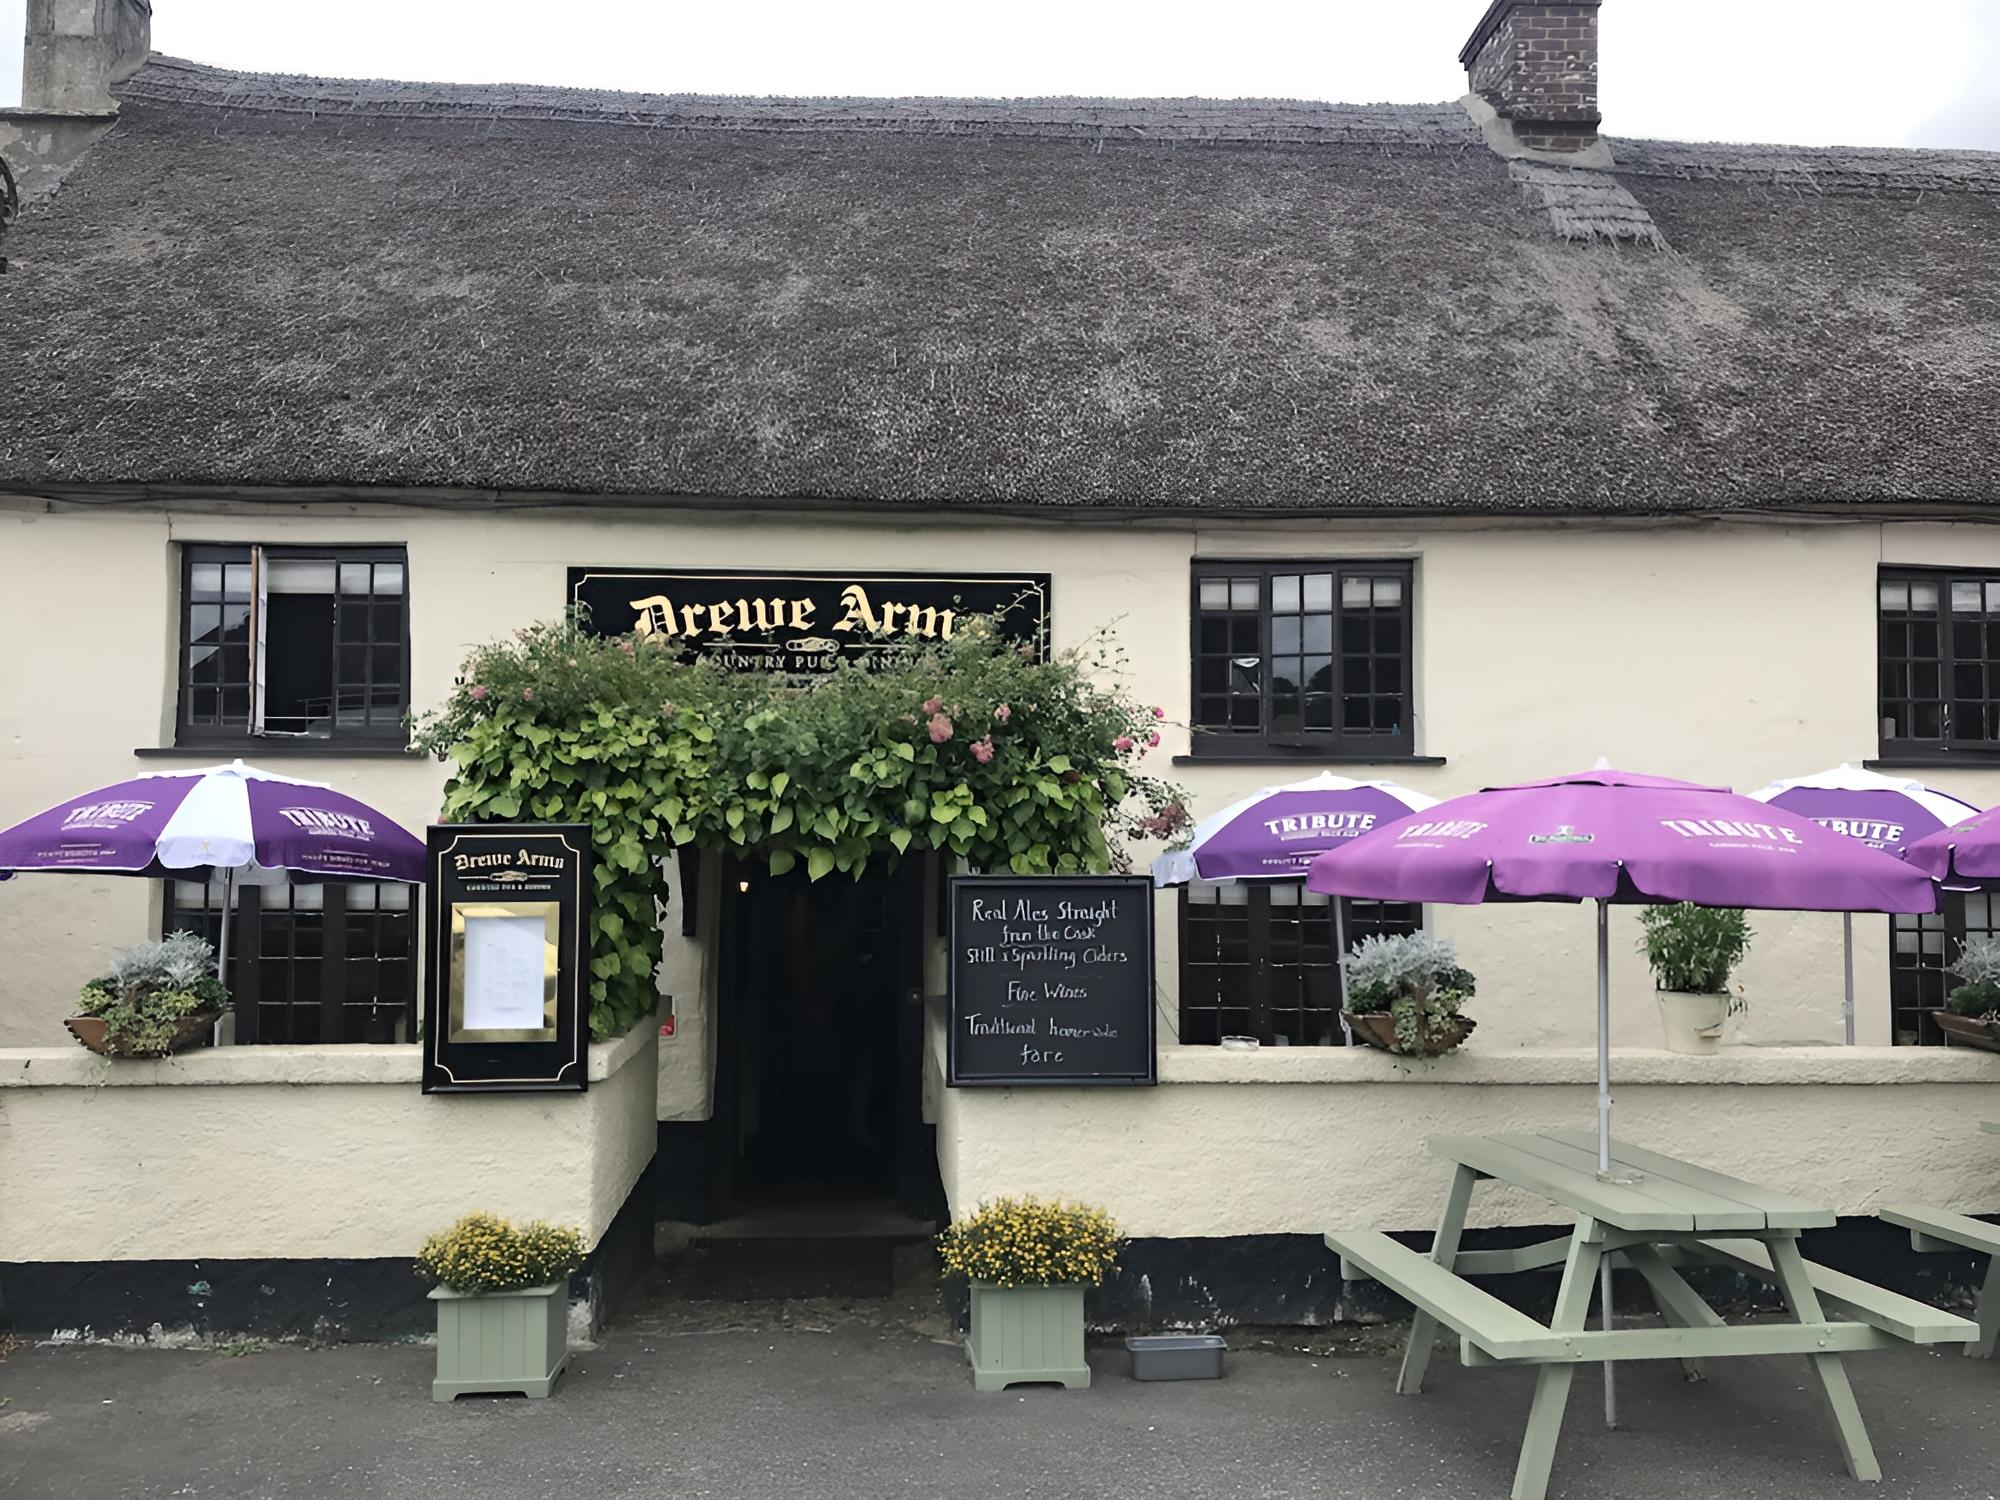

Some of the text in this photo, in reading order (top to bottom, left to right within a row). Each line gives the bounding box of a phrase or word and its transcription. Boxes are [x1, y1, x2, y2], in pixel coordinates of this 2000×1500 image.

[630, 584, 957, 642] Drewe Arm
[795, 655, 832, 669] PU
[1264, 814, 1376, 834] TRIBUTE
[1660, 820, 1803, 844] TRIBUTE
[1817, 819, 1905, 842] IBUTE
[454, 848, 564, 871] Drewe Arms
[972, 899, 1118, 928] Real Ales Straight
[1038, 924, 1060, 940] the
[967, 946, 995, 963] Still
[1008, 980, 1088, 1001] Fine Wines
